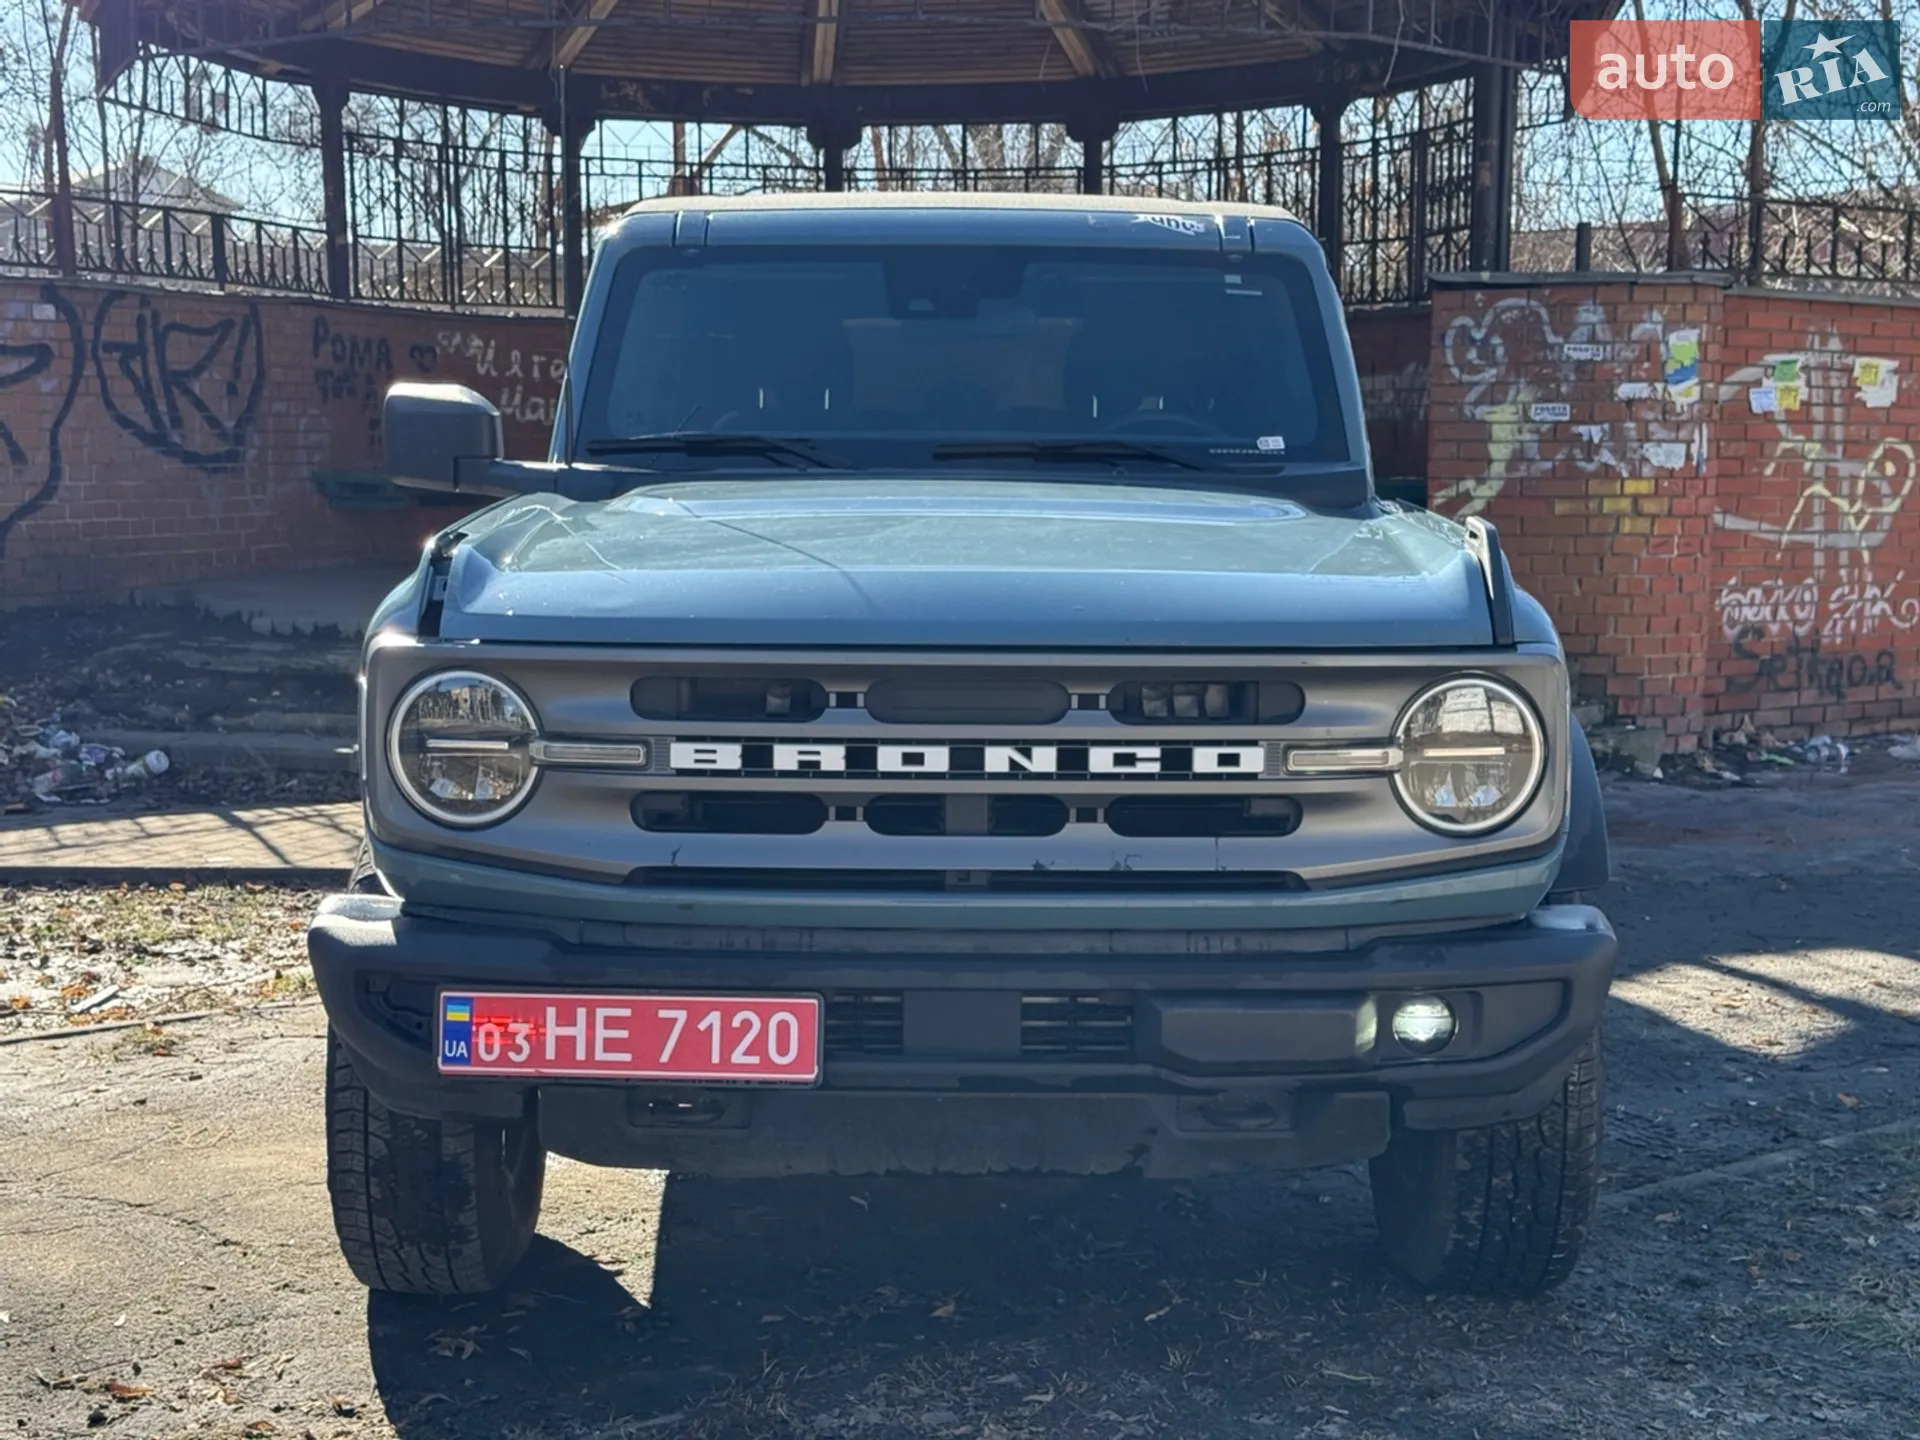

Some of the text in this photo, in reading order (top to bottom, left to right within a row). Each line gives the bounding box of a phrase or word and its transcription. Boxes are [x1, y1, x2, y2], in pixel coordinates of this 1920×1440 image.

[669, 742, 1265, 773] BRONCO
[444, 1040, 468, 1059] UA
[657, 1009, 799, 1066] 7120
